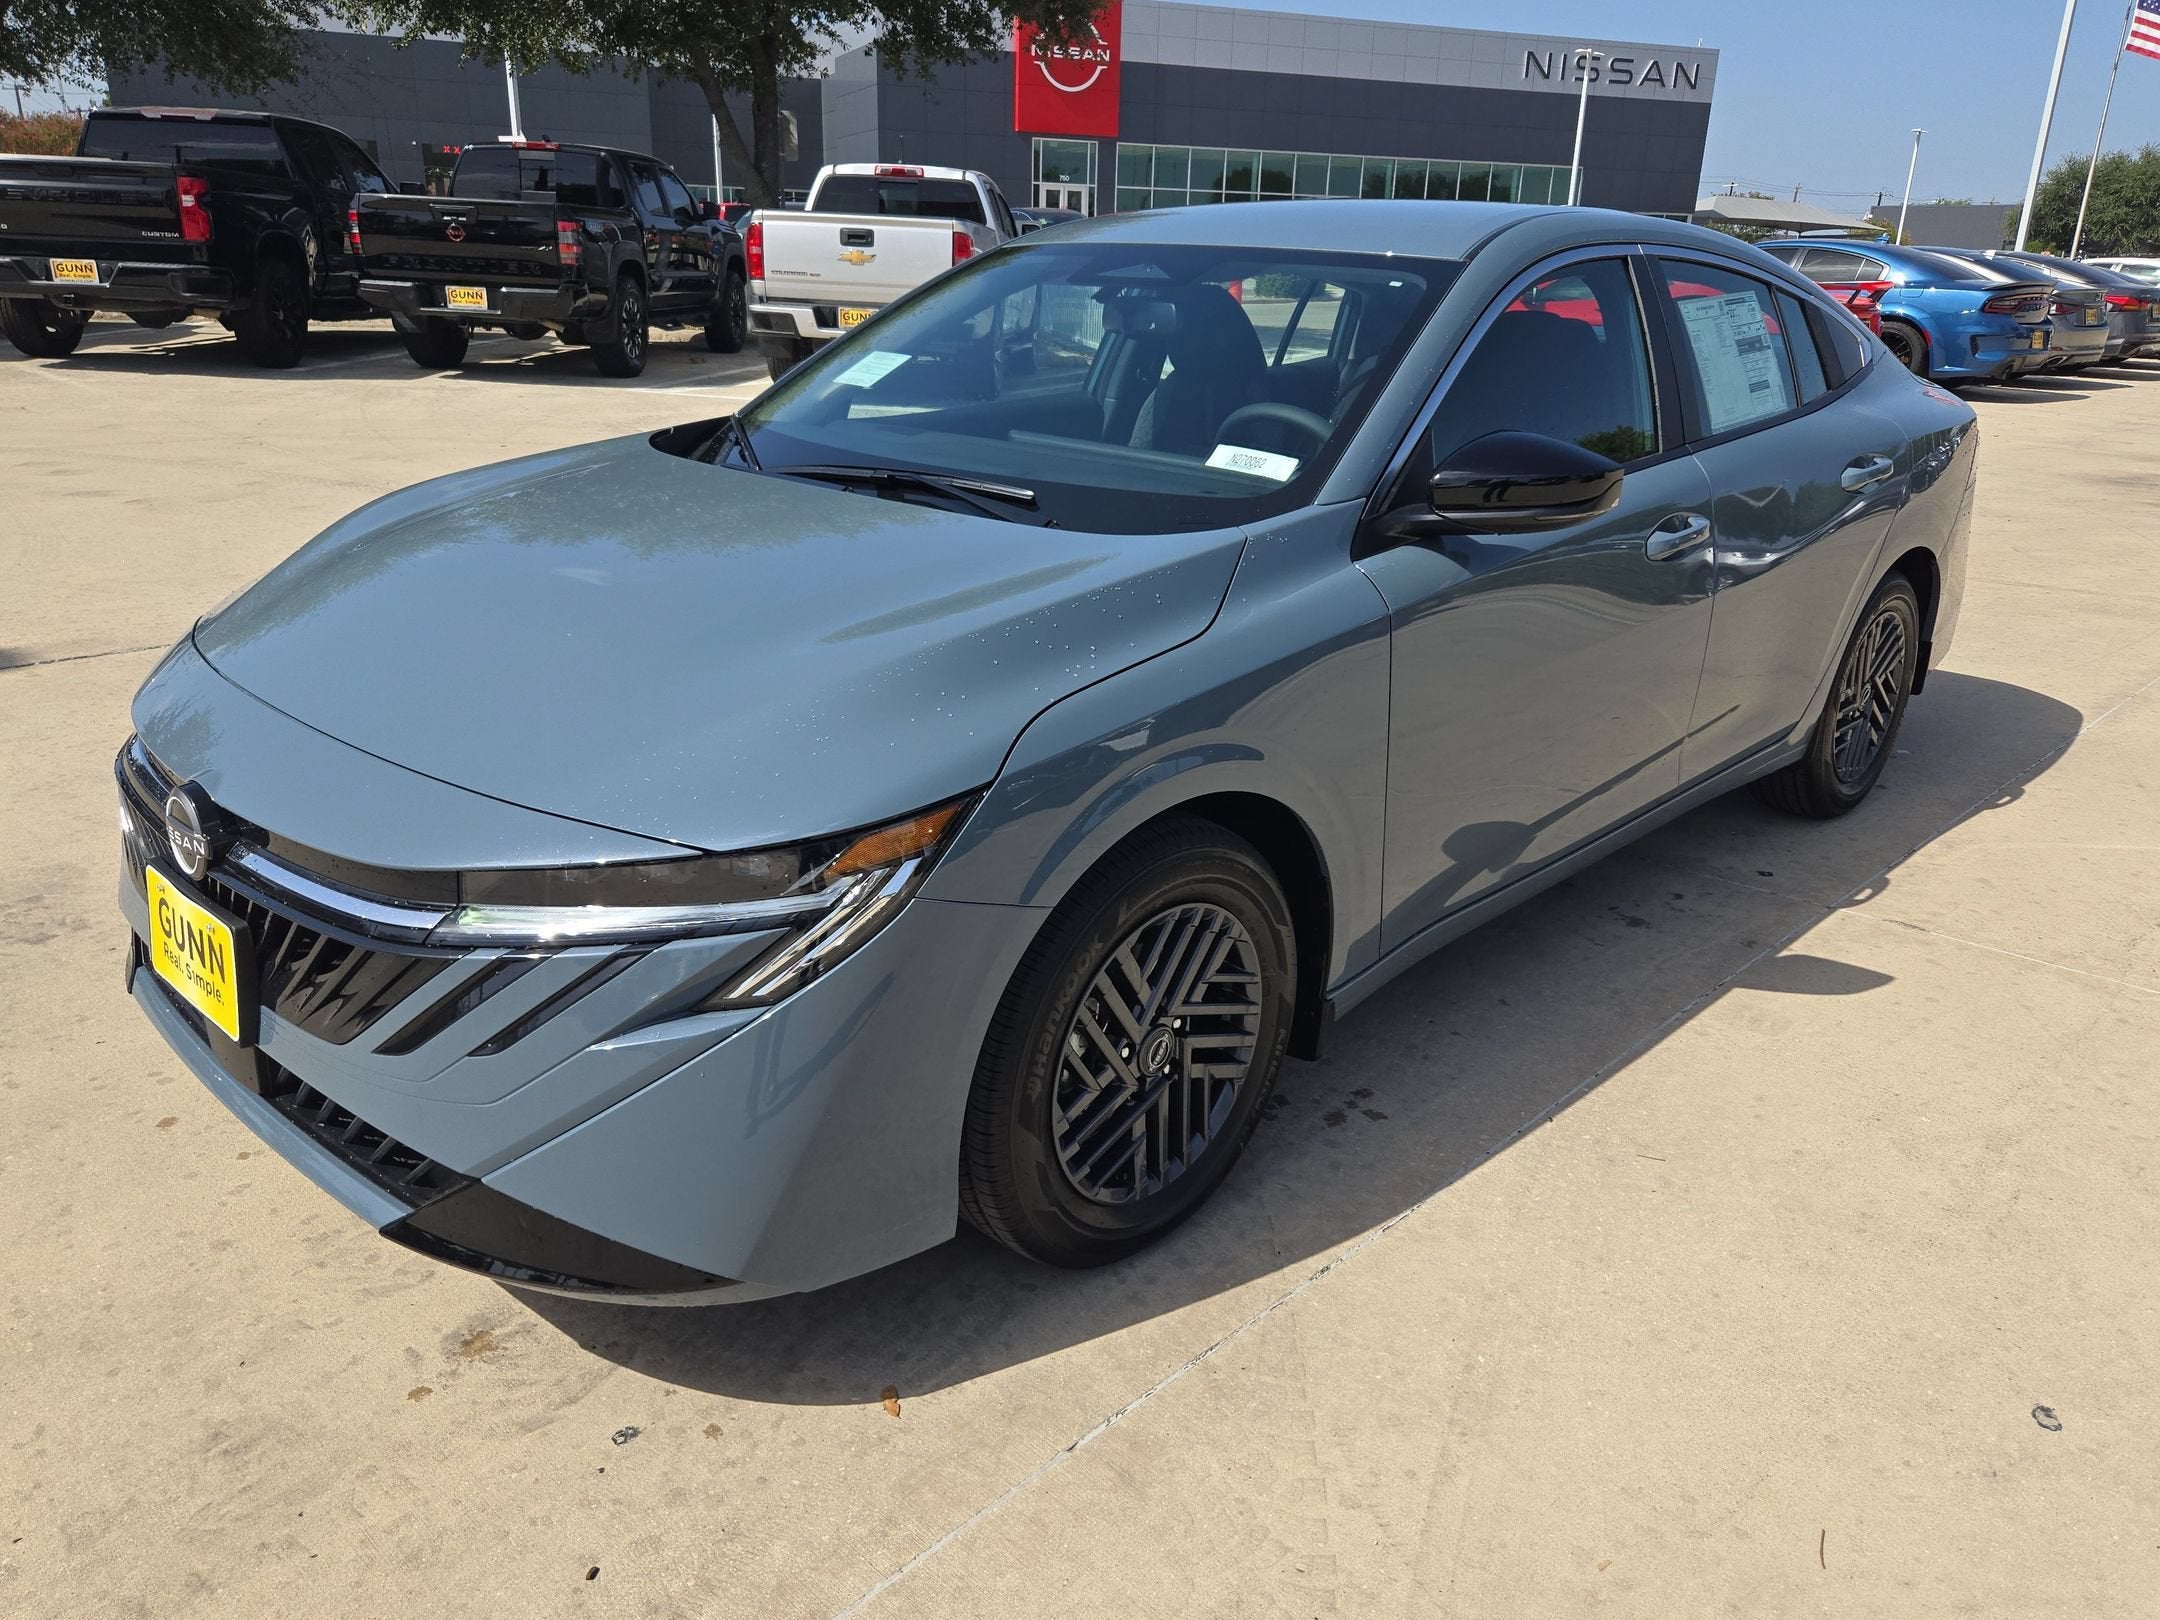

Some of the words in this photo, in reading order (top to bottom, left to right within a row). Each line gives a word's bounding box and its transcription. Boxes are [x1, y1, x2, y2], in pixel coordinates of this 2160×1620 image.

[1522, 50, 1701, 90] NISSAN
[141, 230, 180, 238] CUSTOM
[56, 263, 94, 273] GUNN
[450, 290, 483, 300] GUNN
[167, 825, 206, 856] SSAN
[158, 896, 226, 985] GUNN
[163, 940, 185, 974] Real.
[185, 962, 225, 1007] Simple.
